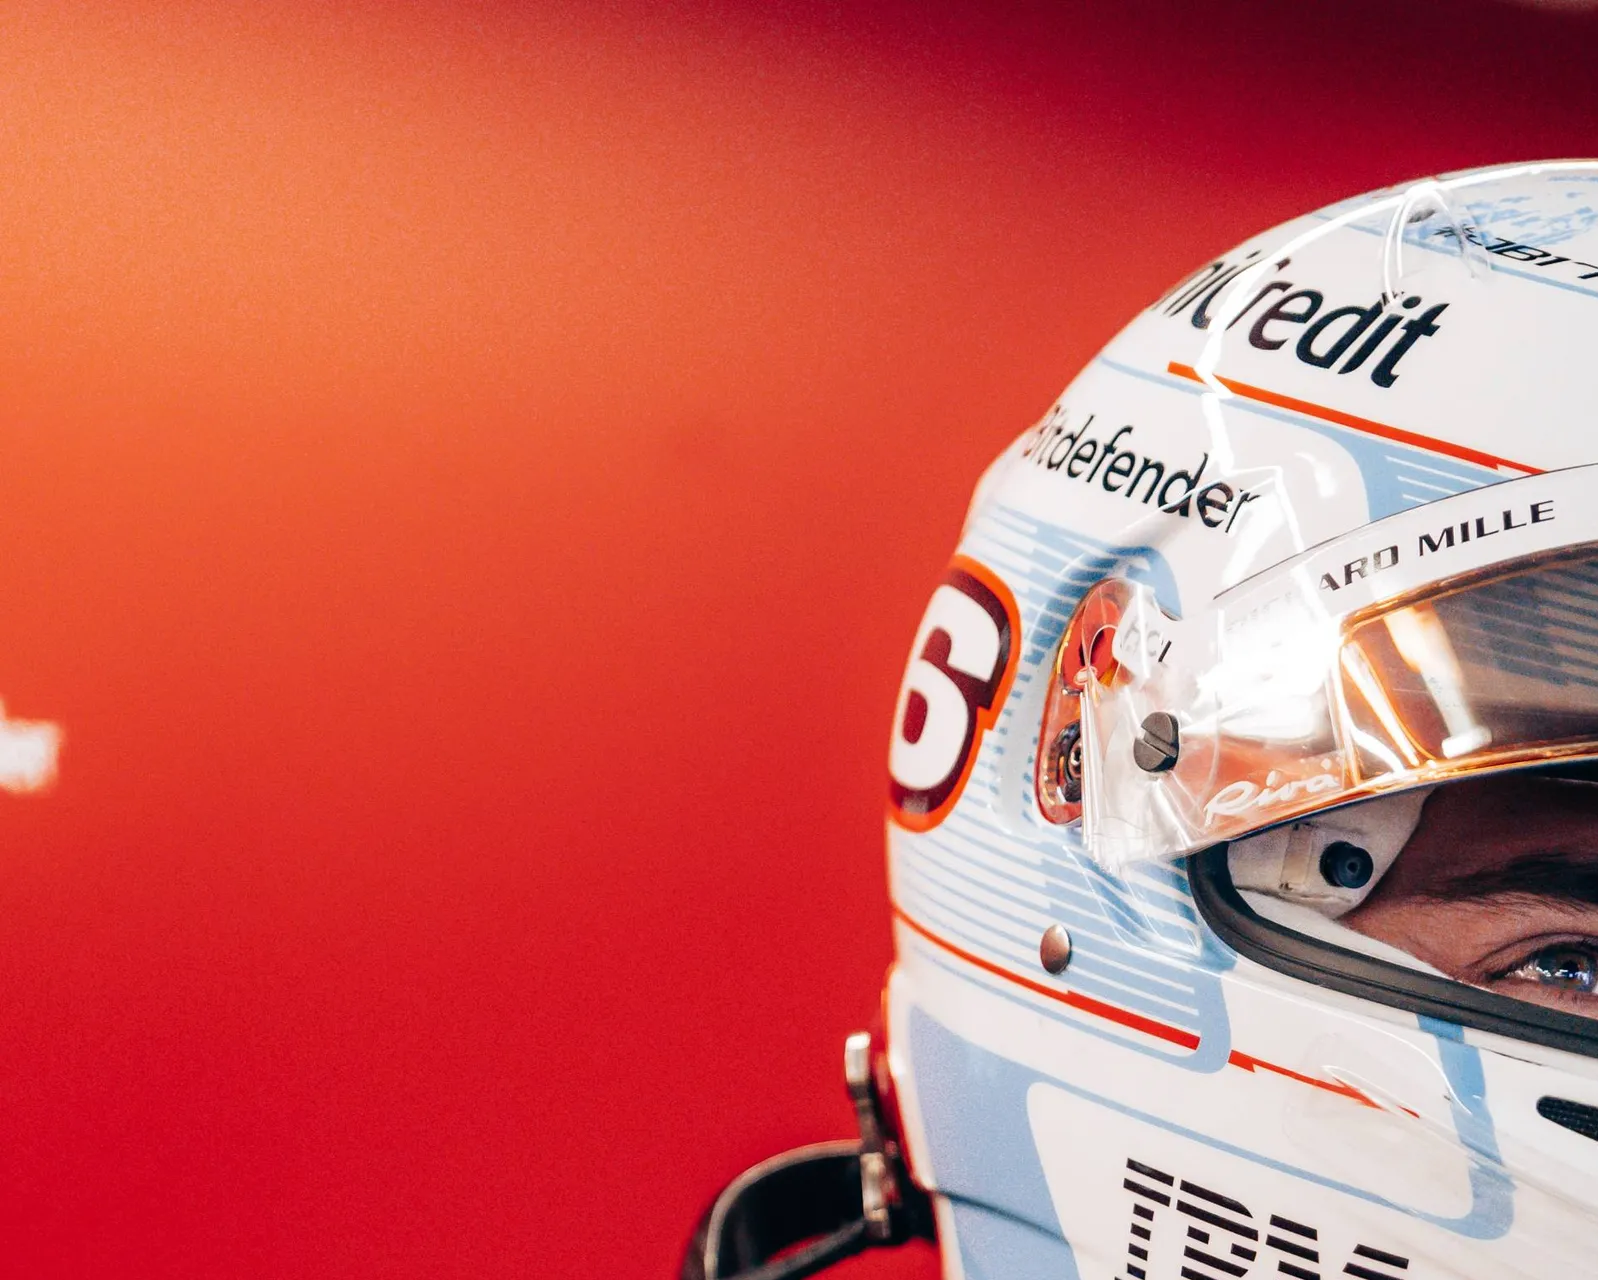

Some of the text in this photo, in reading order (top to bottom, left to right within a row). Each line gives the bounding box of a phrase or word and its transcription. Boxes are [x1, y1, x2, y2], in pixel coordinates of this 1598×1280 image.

[1418, 499, 1555, 557] MILLE
[888, 583, 1001, 791] 6
[1203, 757, 1340, 828] Riva
